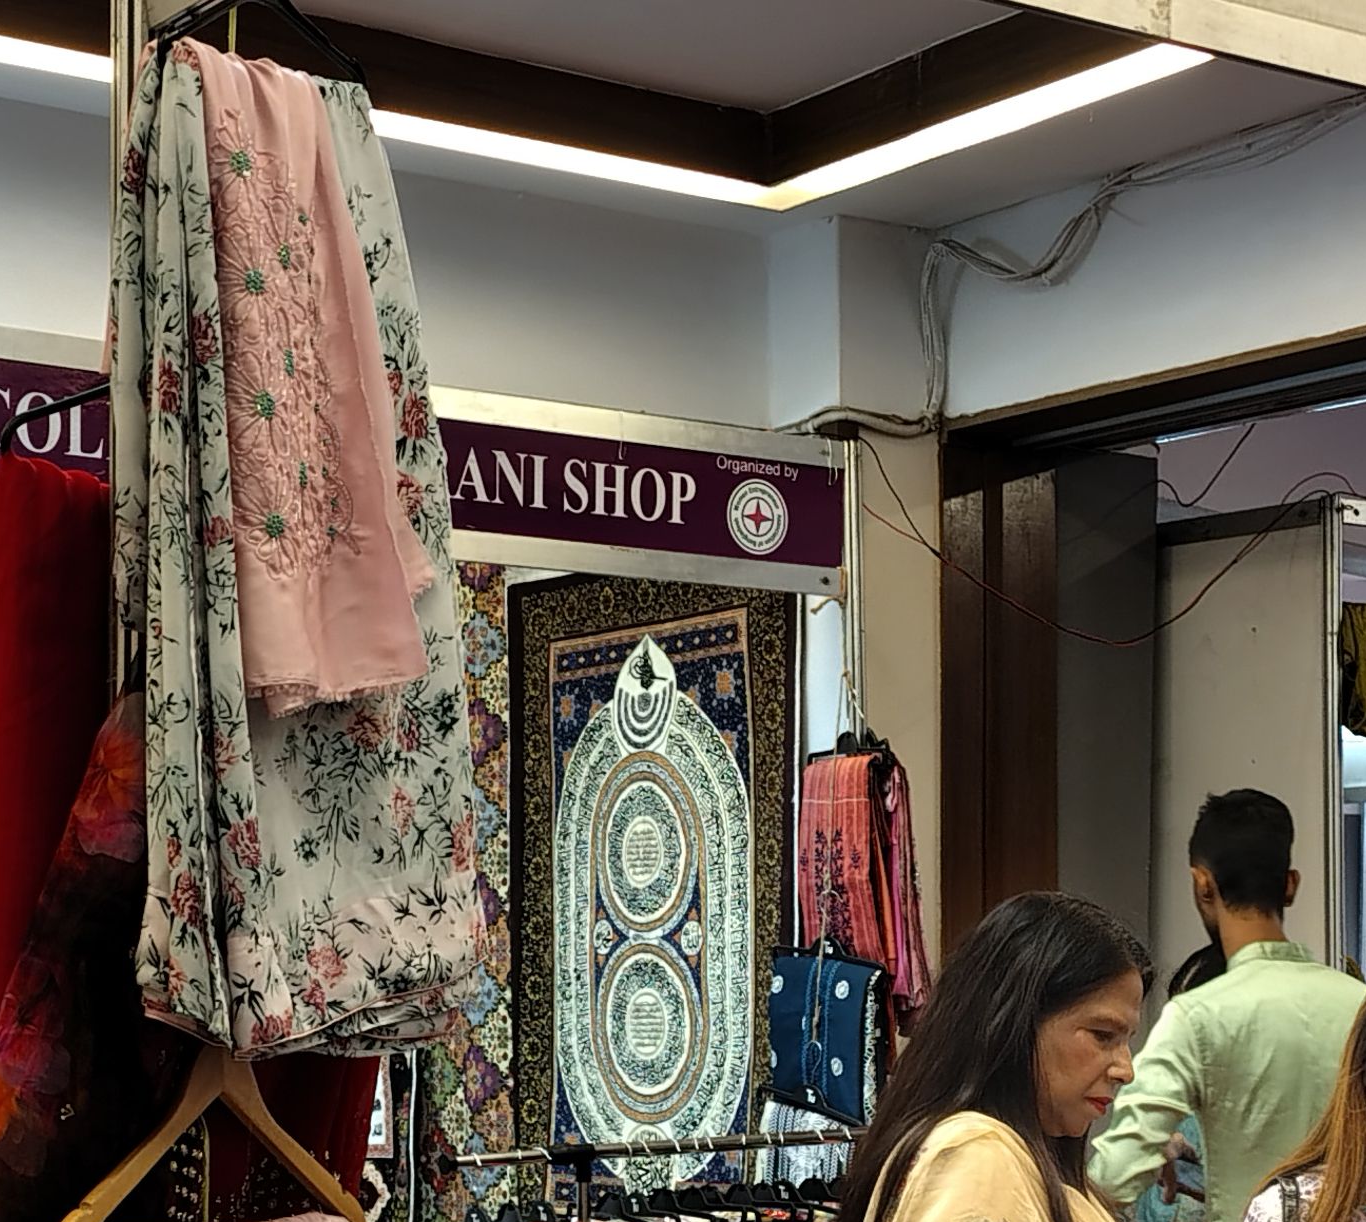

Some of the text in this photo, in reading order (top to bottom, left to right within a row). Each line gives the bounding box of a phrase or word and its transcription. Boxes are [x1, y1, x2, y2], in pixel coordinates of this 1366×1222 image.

[716, 455, 799, 482] Organized by
[449, 446, 549, 510] ANI
[562, 457, 697, 525] SHOP
[778, 1185, 790, 1200] Tu
